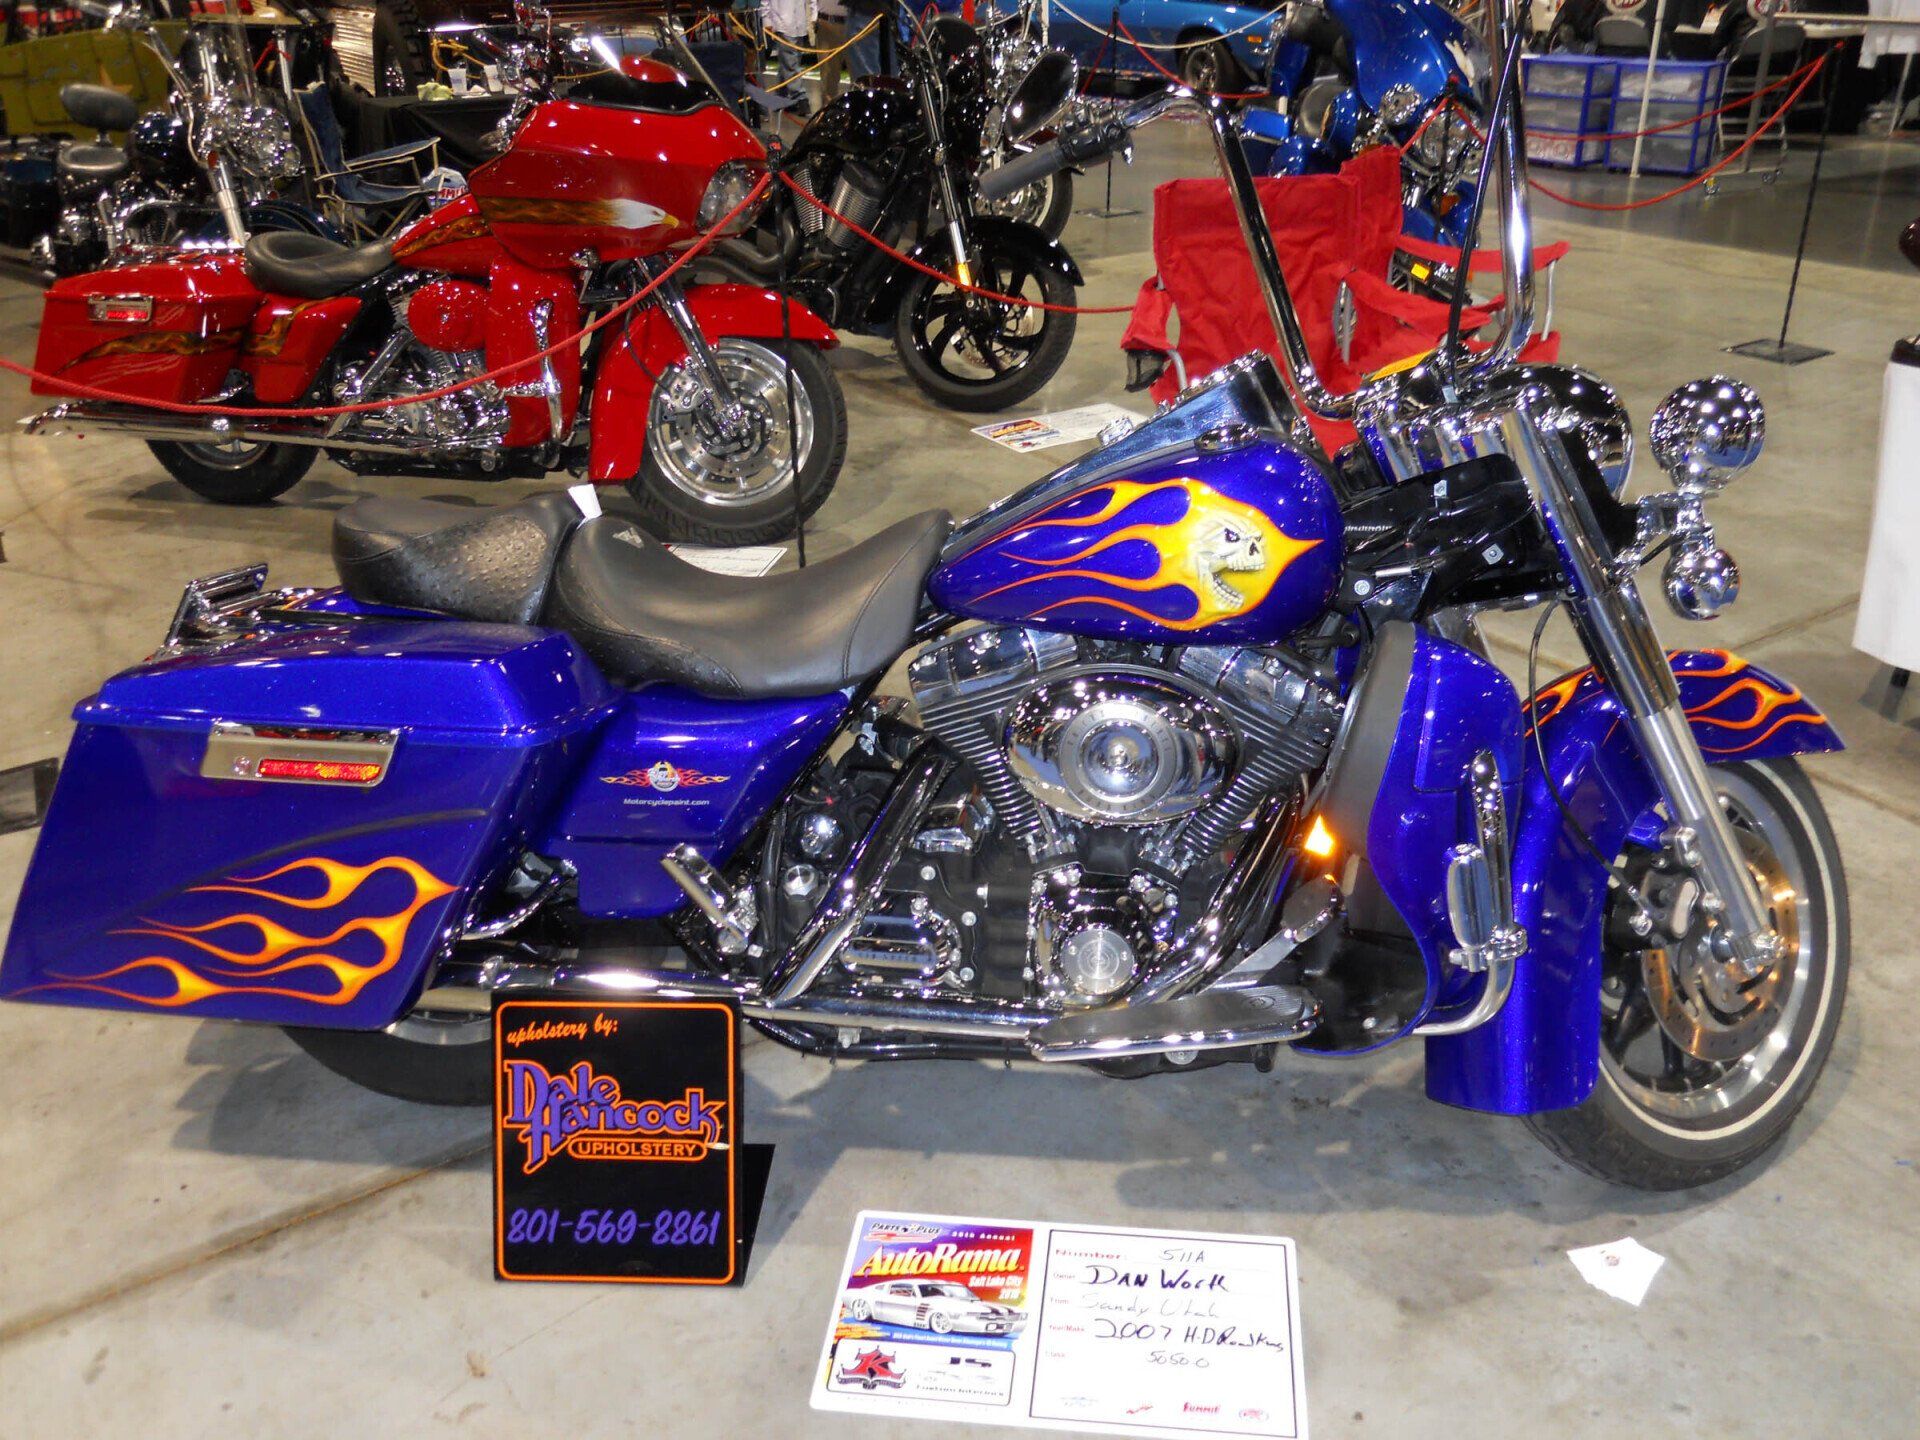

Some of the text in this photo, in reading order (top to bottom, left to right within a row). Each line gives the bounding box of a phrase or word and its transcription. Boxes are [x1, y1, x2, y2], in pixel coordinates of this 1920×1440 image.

[623, 798, 710, 807] Motorcyclepaint.com
[506, 1012, 619, 1047] upholstery by:
[503, 1060, 621, 1128] Dale
[517, 1088, 727, 1175] Hancock
[577, 1142, 697, 1157] UPHOLSTERY
[506, 1207, 721, 1246] 801-569-8861
[853, 1243, 1024, 1277] AutoRama
